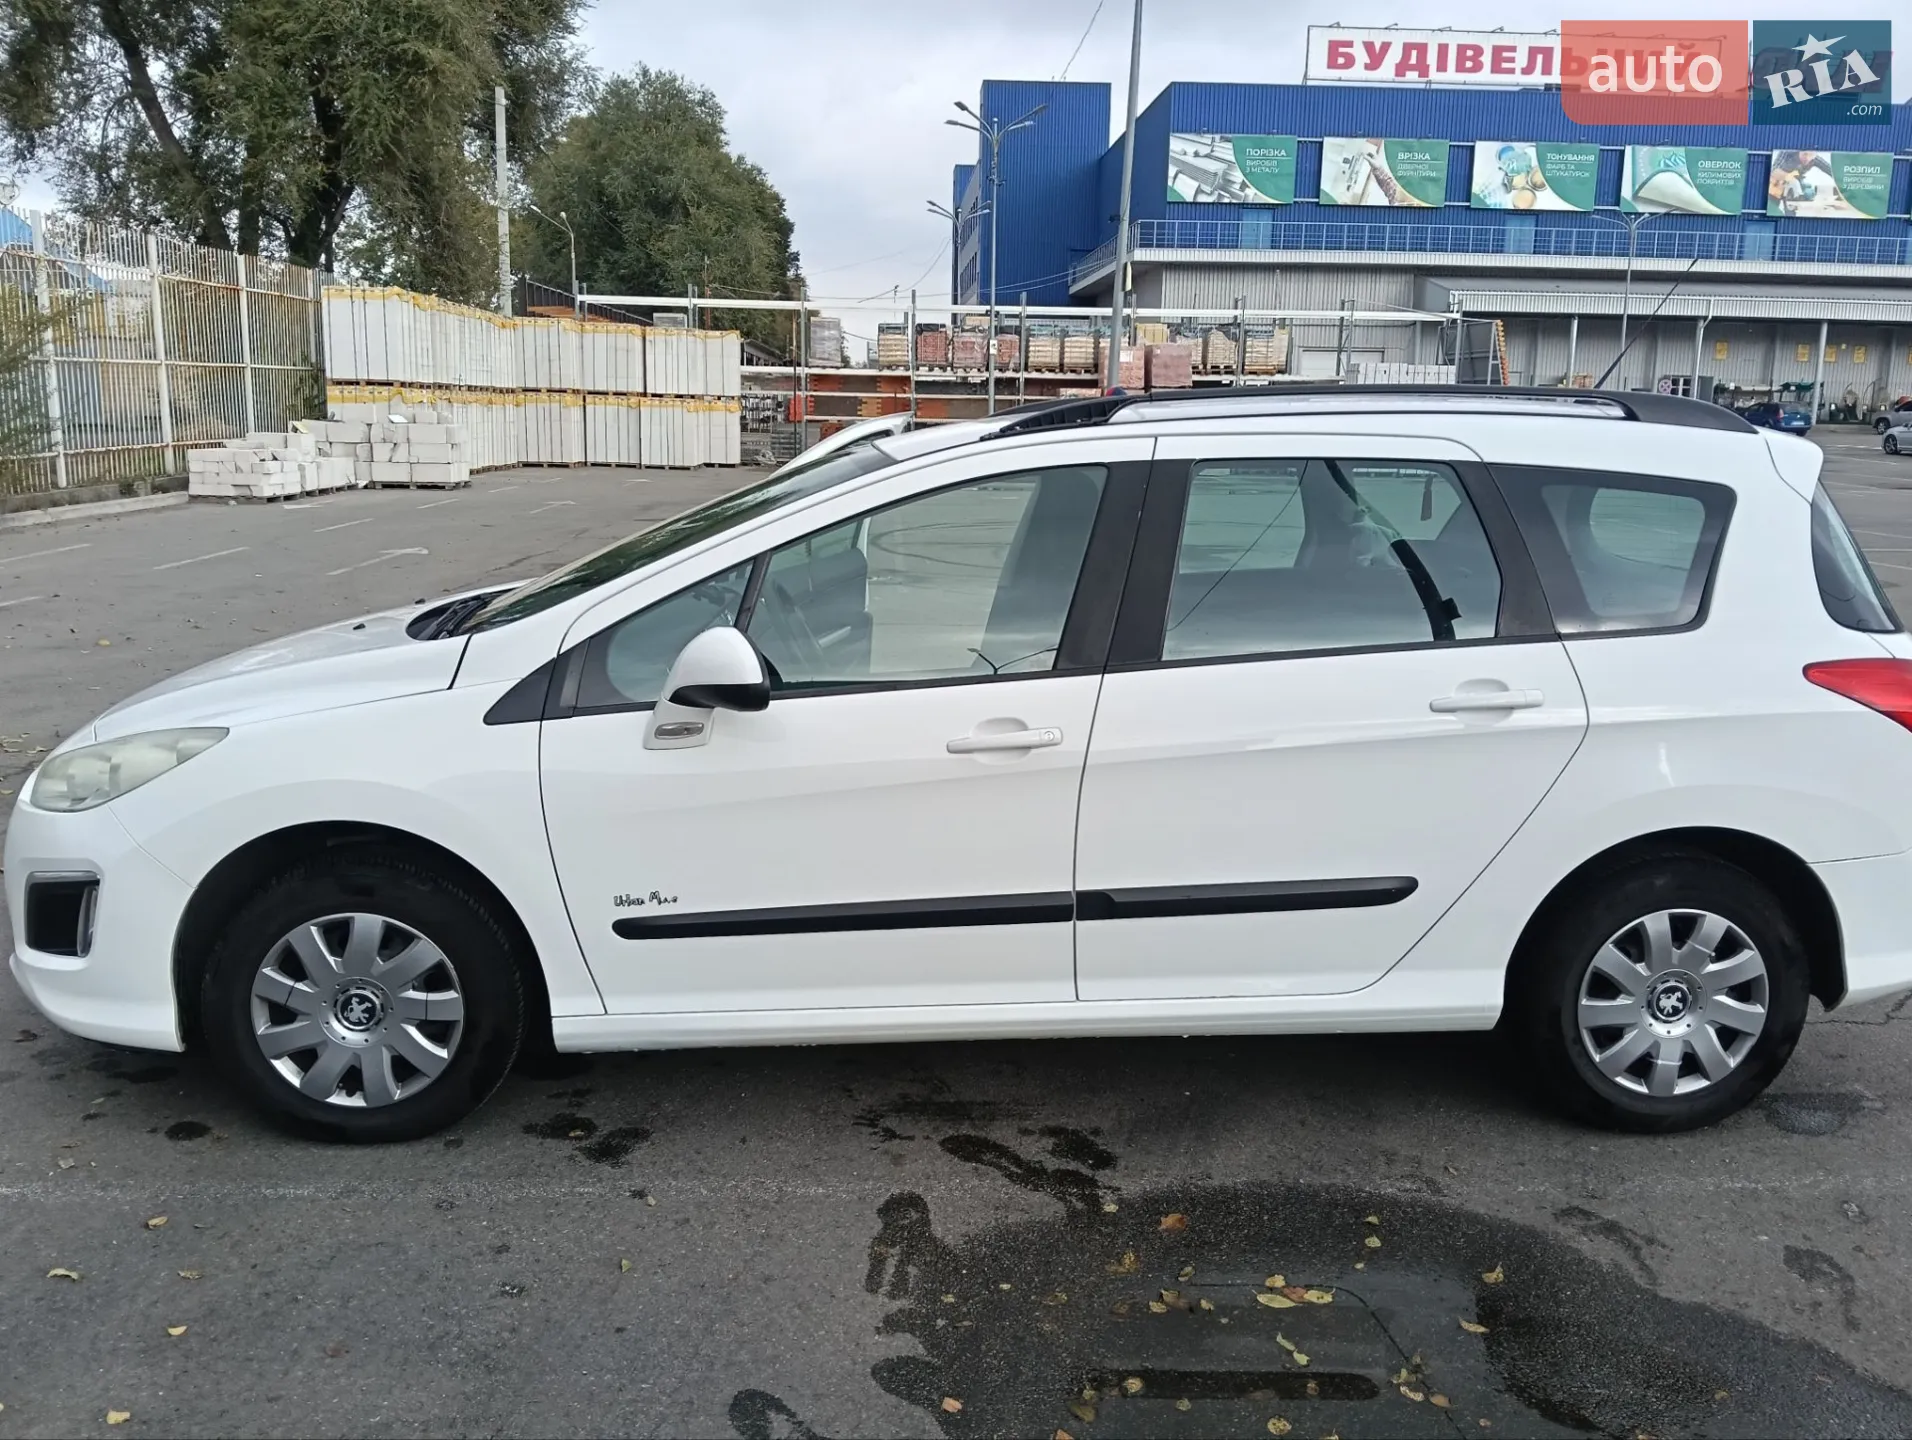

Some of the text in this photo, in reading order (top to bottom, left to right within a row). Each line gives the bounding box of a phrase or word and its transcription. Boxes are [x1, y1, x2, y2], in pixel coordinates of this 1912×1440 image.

[1246, 148, 1287, 157] ПОРІЗКА
[1397, 151, 1431, 160] ВРІЗКА
[1546, 152, 1595, 162] ТОНУВАННЯ
[1246, 159, 1278, 167] ВИРОБІВ
[1697, 159, 1742, 169] ОВЕРЛОК
[1545, 170, 1591, 178] ШТУКАТУРОК
[1843, 165, 1881, 174] РОЗПИЛ
